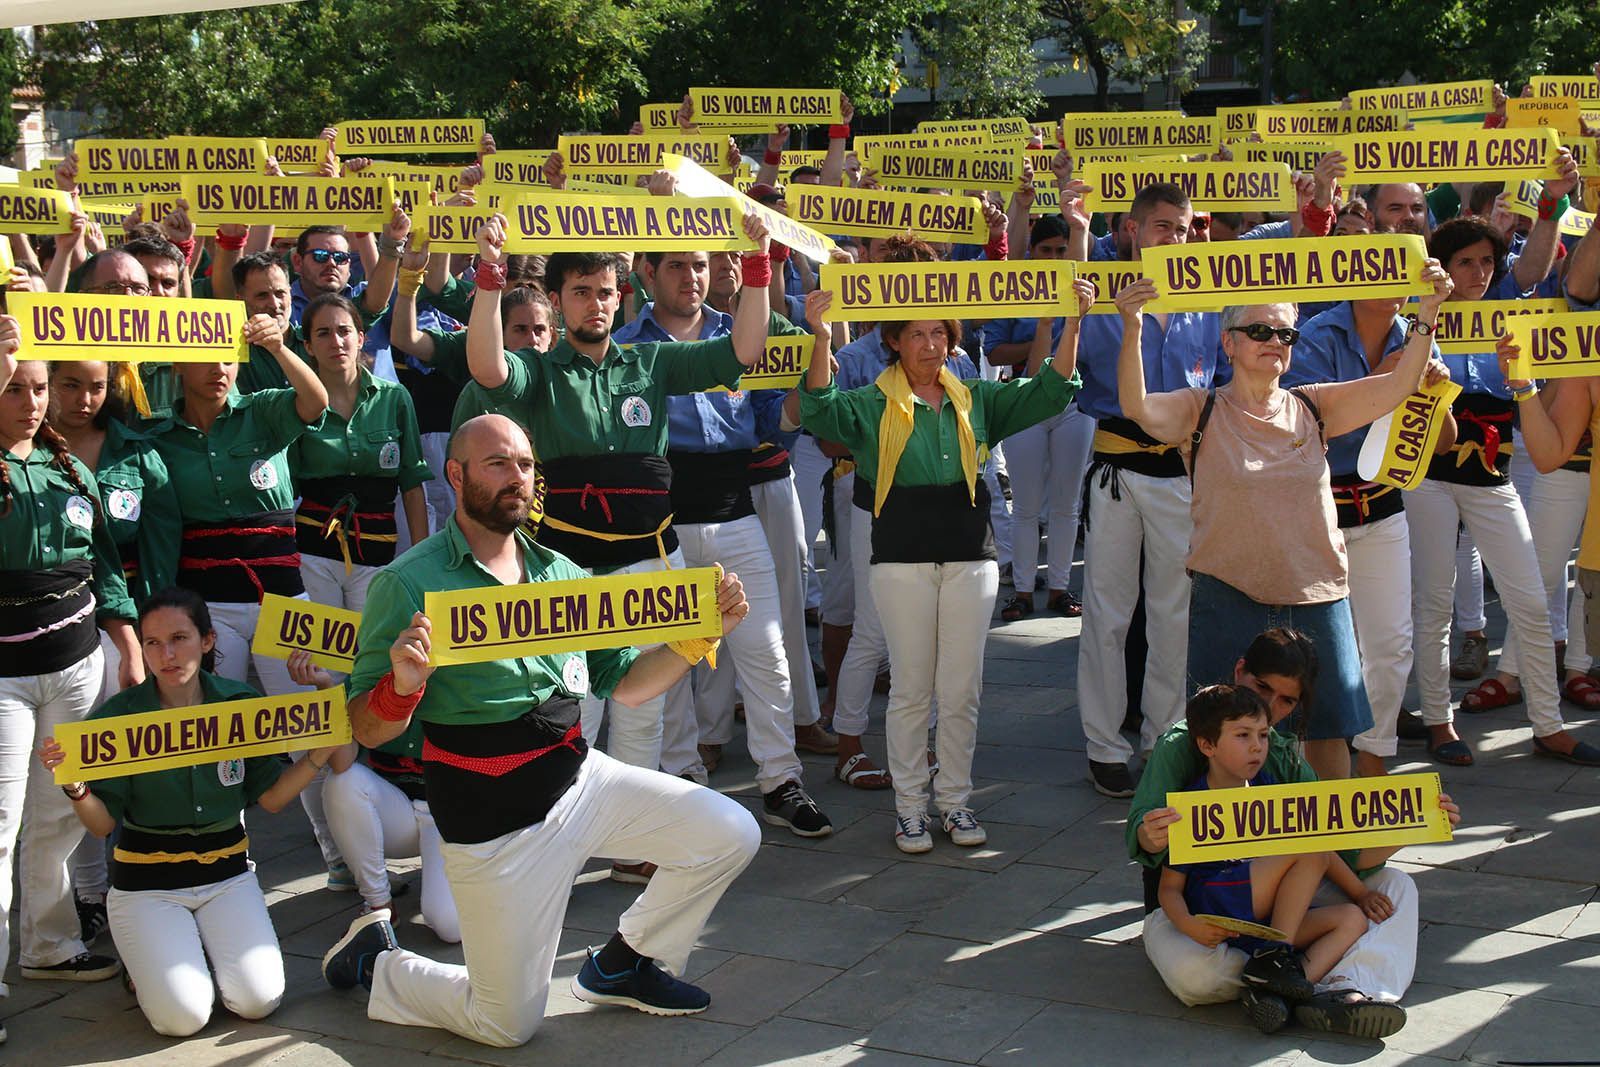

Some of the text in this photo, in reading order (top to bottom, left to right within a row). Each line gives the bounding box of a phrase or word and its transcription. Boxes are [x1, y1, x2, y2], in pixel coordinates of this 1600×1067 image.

[1430, 89, 1440, 107] A
[1443, 86, 1484, 106] CASA!
[1562, 82, 1600, 99] VOLE
[701, 95, 831, 114] US VOLEM A CASA!
[1519, 101, 1569, 111] REPÚBLICA
[650, 109, 667, 127] US
[990, 122, 1025, 135] CASA!
[1226, 113, 1244, 130] US
[1268, 115, 1398, 134] US VOLEM A CASA!
[346, 125, 474, 145] US VOLEM A CASA!
[1074, 124, 1212, 147] US VOLEM A CASA!
[88, 147, 256, 171] US VOLEM A CASA!
[275, 145, 317, 162] CASA!
[569, 142, 591, 164] US
[596, 143, 650, 164] VOLEM
[1354, 138, 1548, 170] US VOLEM A CASA!
[1562, 144, 1588, 165] A!
[494, 161, 551, 185] US VOL
[881, 155, 1014, 181] US VOLEM A CASA!
[197, 184, 384, 211] US VOLEM A CASA!
[1101, 172, 1127, 199] US
[1204, 172, 1217, 198] A
[1222, 172, 1279, 198] CASA!
[0, 196, 58, 221] CASA!
[517, 204, 736, 237] US VOLEM A CASA!
[800, 194, 975, 231] US VOLEM A CASA!
[428, 215, 494, 240] US VO
[1166, 247, 1409, 290] US VOLEM A CASA!
[841, 273, 872, 305] US
[878, 272, 959, 304] VOLEM
[966, 272, 982, 302] A
[989, 270, 1058, 301] CASA!
[33, 305, 233, 344] US VOLEM A CASA!
[1470, 310, 1485, 338] A
[1531, 326, 1568, 361] US
[1386, 391, 1436, 485] A CASA!
[450, 602, 488, 644] US
[496, 595, 589, 640] VOLEM
[597, 591, 616, 629] A
[623, 583, 700, 627] CASA!
[280, 610, 358, 656] US VO
[79, 700, 331, 765] US VOLEM A CASA!
[1191, 787, 1425, 842] US VOLEM A CASA!
